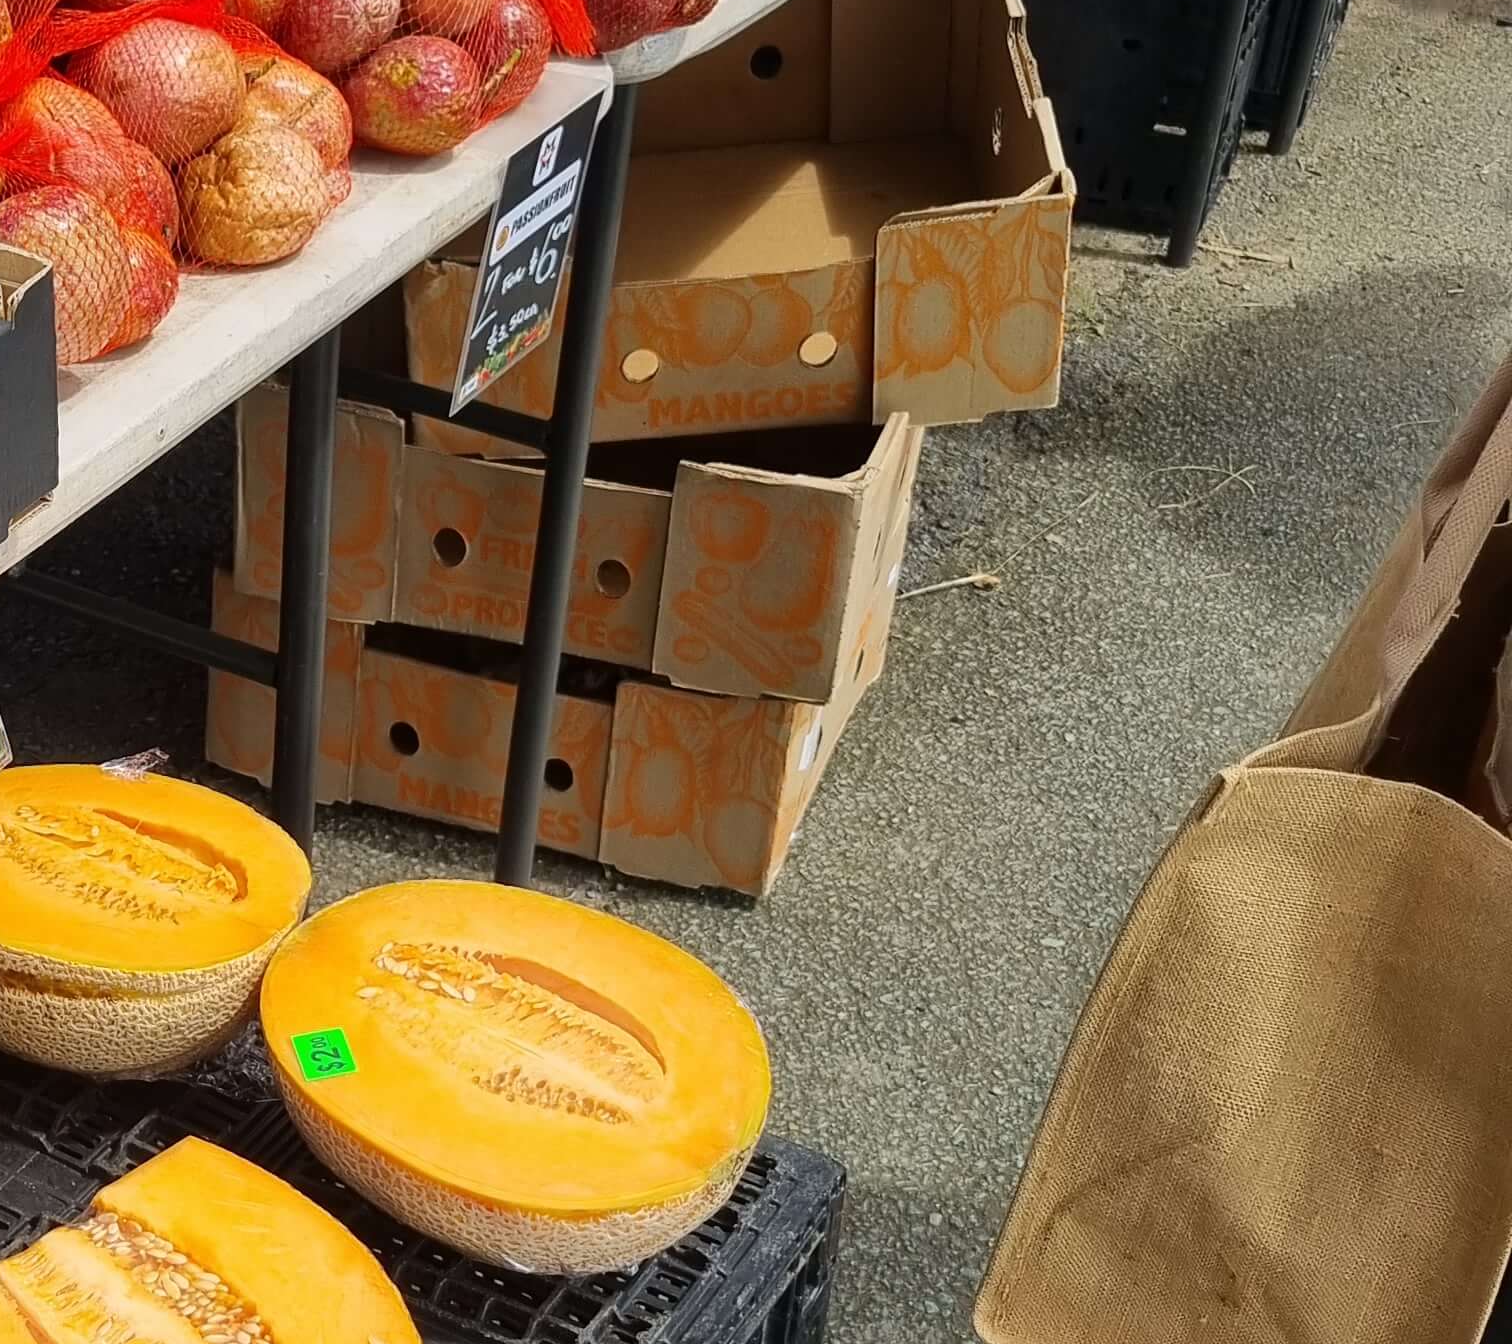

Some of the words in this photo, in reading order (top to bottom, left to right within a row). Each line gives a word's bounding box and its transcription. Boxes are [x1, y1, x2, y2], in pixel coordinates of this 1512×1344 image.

[509, 174, 577, 238] PASSIONFRUIT
[469, 264, 499, 340] 2
[648, 381, 858, 430] MANGOES
[453, 594, 608, 649] PROCE
[399, 771, 583, 845] MANGES
